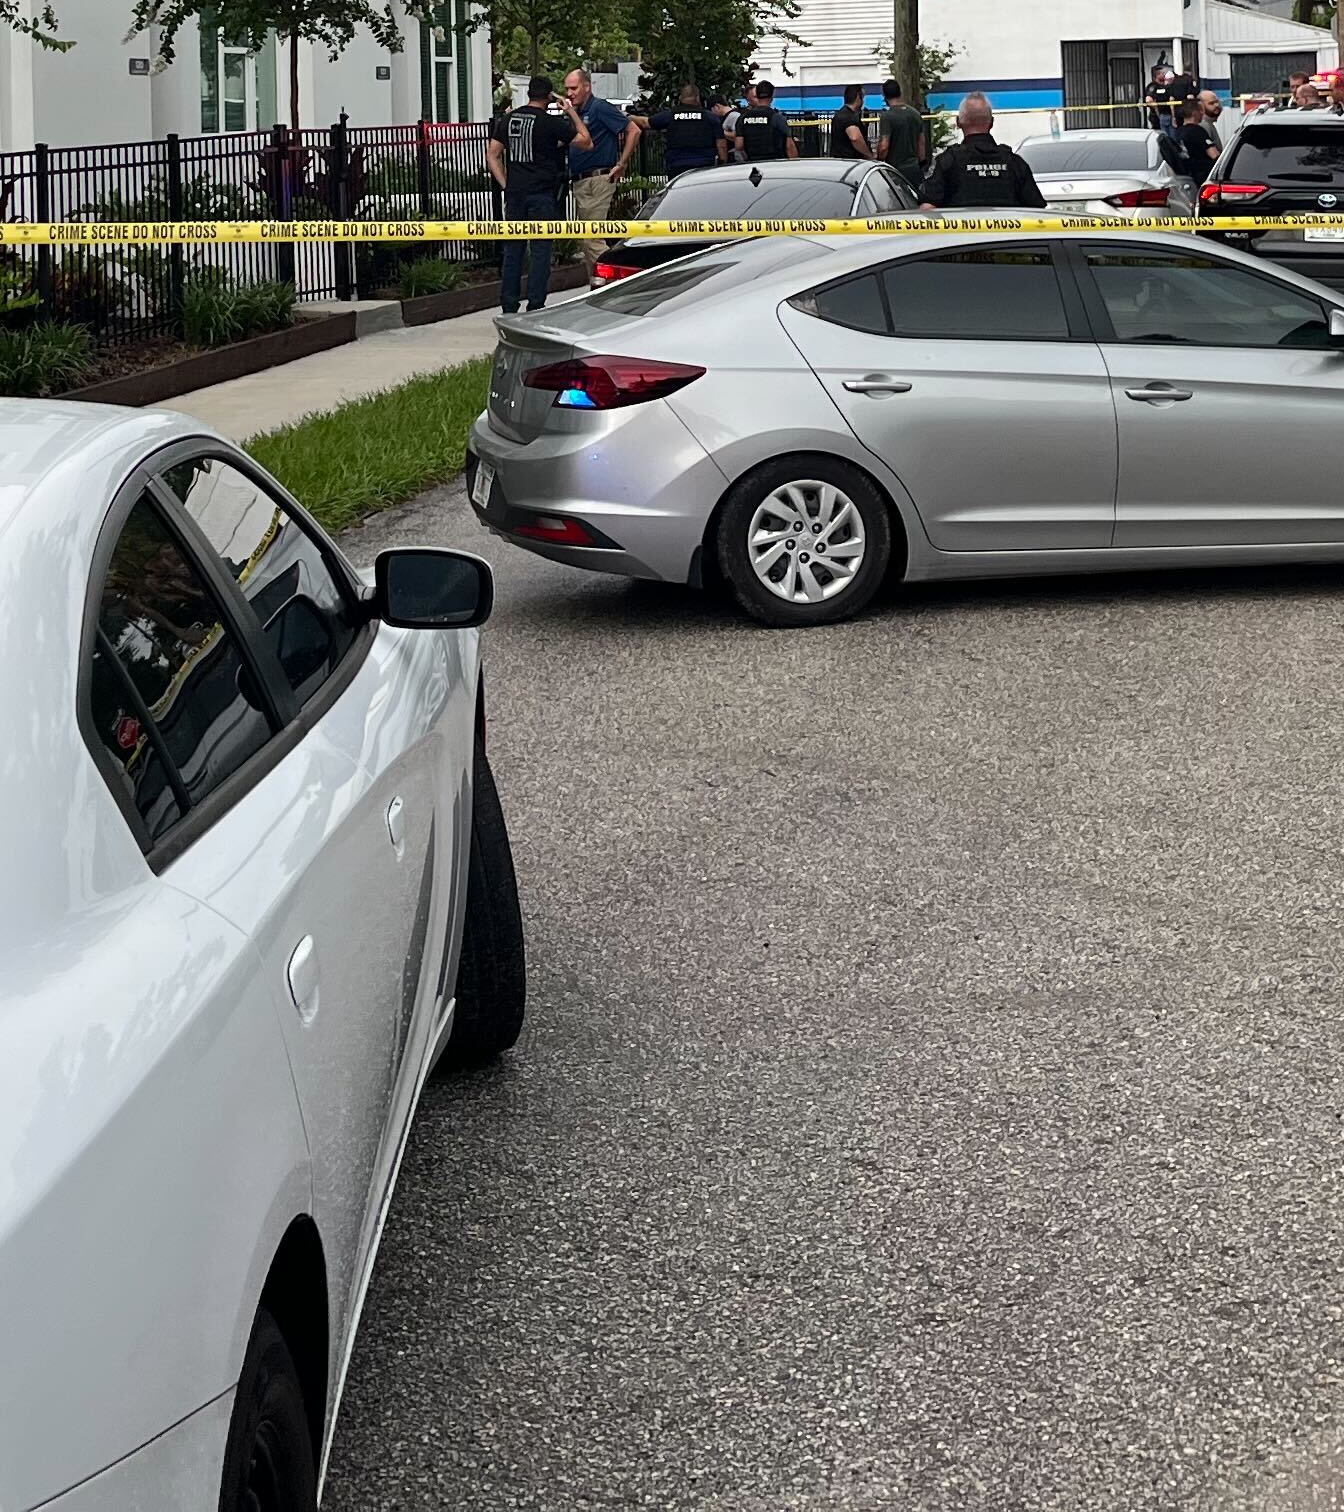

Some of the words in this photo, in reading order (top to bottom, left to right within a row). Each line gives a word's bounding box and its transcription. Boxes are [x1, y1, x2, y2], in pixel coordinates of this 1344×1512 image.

[674, 112, 702, 120] POLICE
[467, 222, 504, 235] CRIME
[508, 221, 543, 235] SCENE
[547, 221, 562, 235] DO
[566, 221, 586, 234] NOT
[591, 221, 628, 234] CROSS
[669, 221, 704, 233] CRIME
[708, 221, 743, 233] SCENE
[747, 220, 762, 233] DO
[765, 220, 786, 232] NOT
[790, 220, 826, 232] CROSS
[867, 220, 902, 231] CRIME
[905, 219, 940, 231] SCENE
[943, 219, 958, 230] DO
[962, 219, 982, 230] NOT
[985, 219, 1022, 229] CROSS
[1061, 218, 1096, 228] CRIME
[1099, 217, 1133, 228] SCENE
[1137, 217, 1152, 227] DO
[1155, 217, 1176, 227] NOT
[1179, 216, 1214, 226] CROSS
[49, 225, 87, 240] CRIME
[91, 225, 129, 240] SCENE
[133, 224, 148, 239] DO
[152, 224, 175, 239] NOT
[179, 224, 217, 239] CROSS
[261, 224, 298, 238] CRIME
[302, 223, 339, 238] SCENE
[342, 223, 357, 238] DO
[362, 223, 383, 238] NOT
[388, 223, 425, 237] CROSS
